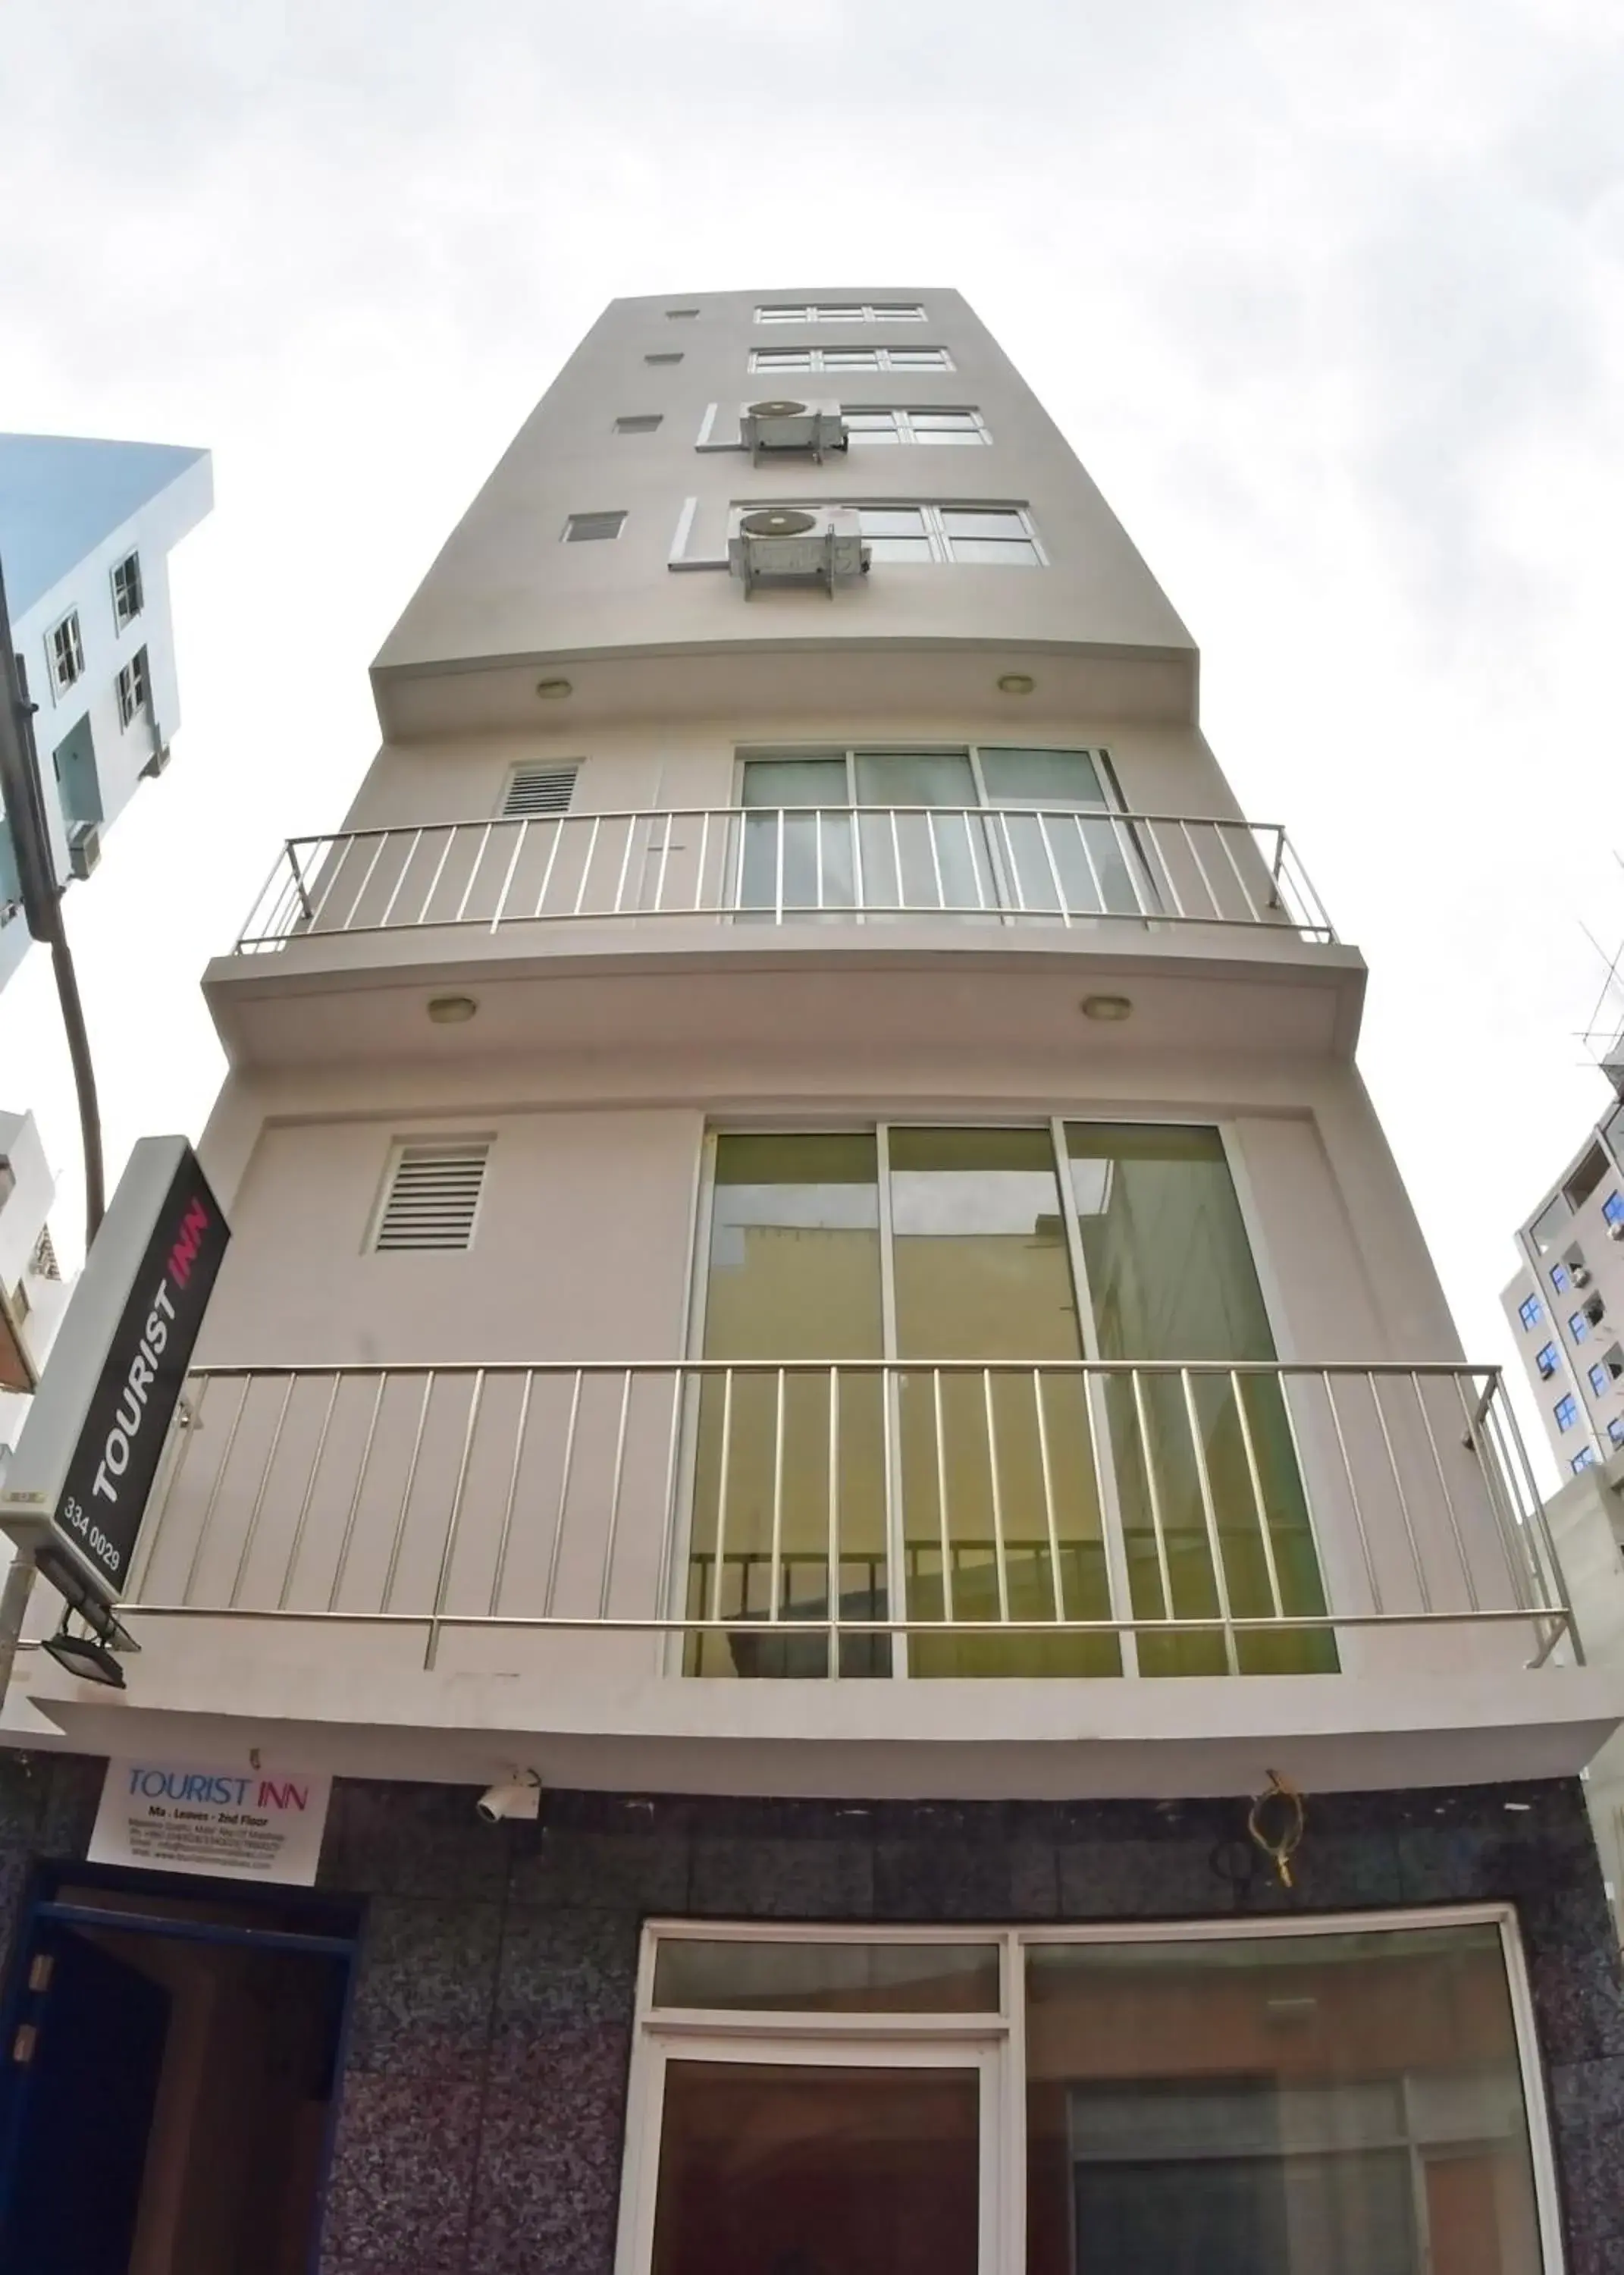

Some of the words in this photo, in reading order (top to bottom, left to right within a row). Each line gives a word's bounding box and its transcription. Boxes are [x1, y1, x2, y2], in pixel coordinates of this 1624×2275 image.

[92, 1279, 174, 1503] TOURIST
[168, 1197, 210, 1288] INN
[64, 1496, 89, 1536] 334
[89, 1527, 120, 1571] 0029
[129, 1769, 252, 1806] TOURIST
[258, 1781, 308, 1810] INN
[218, 1812, 239, 1825] 2nd
[241, 1815, 268, 1826] Floor
